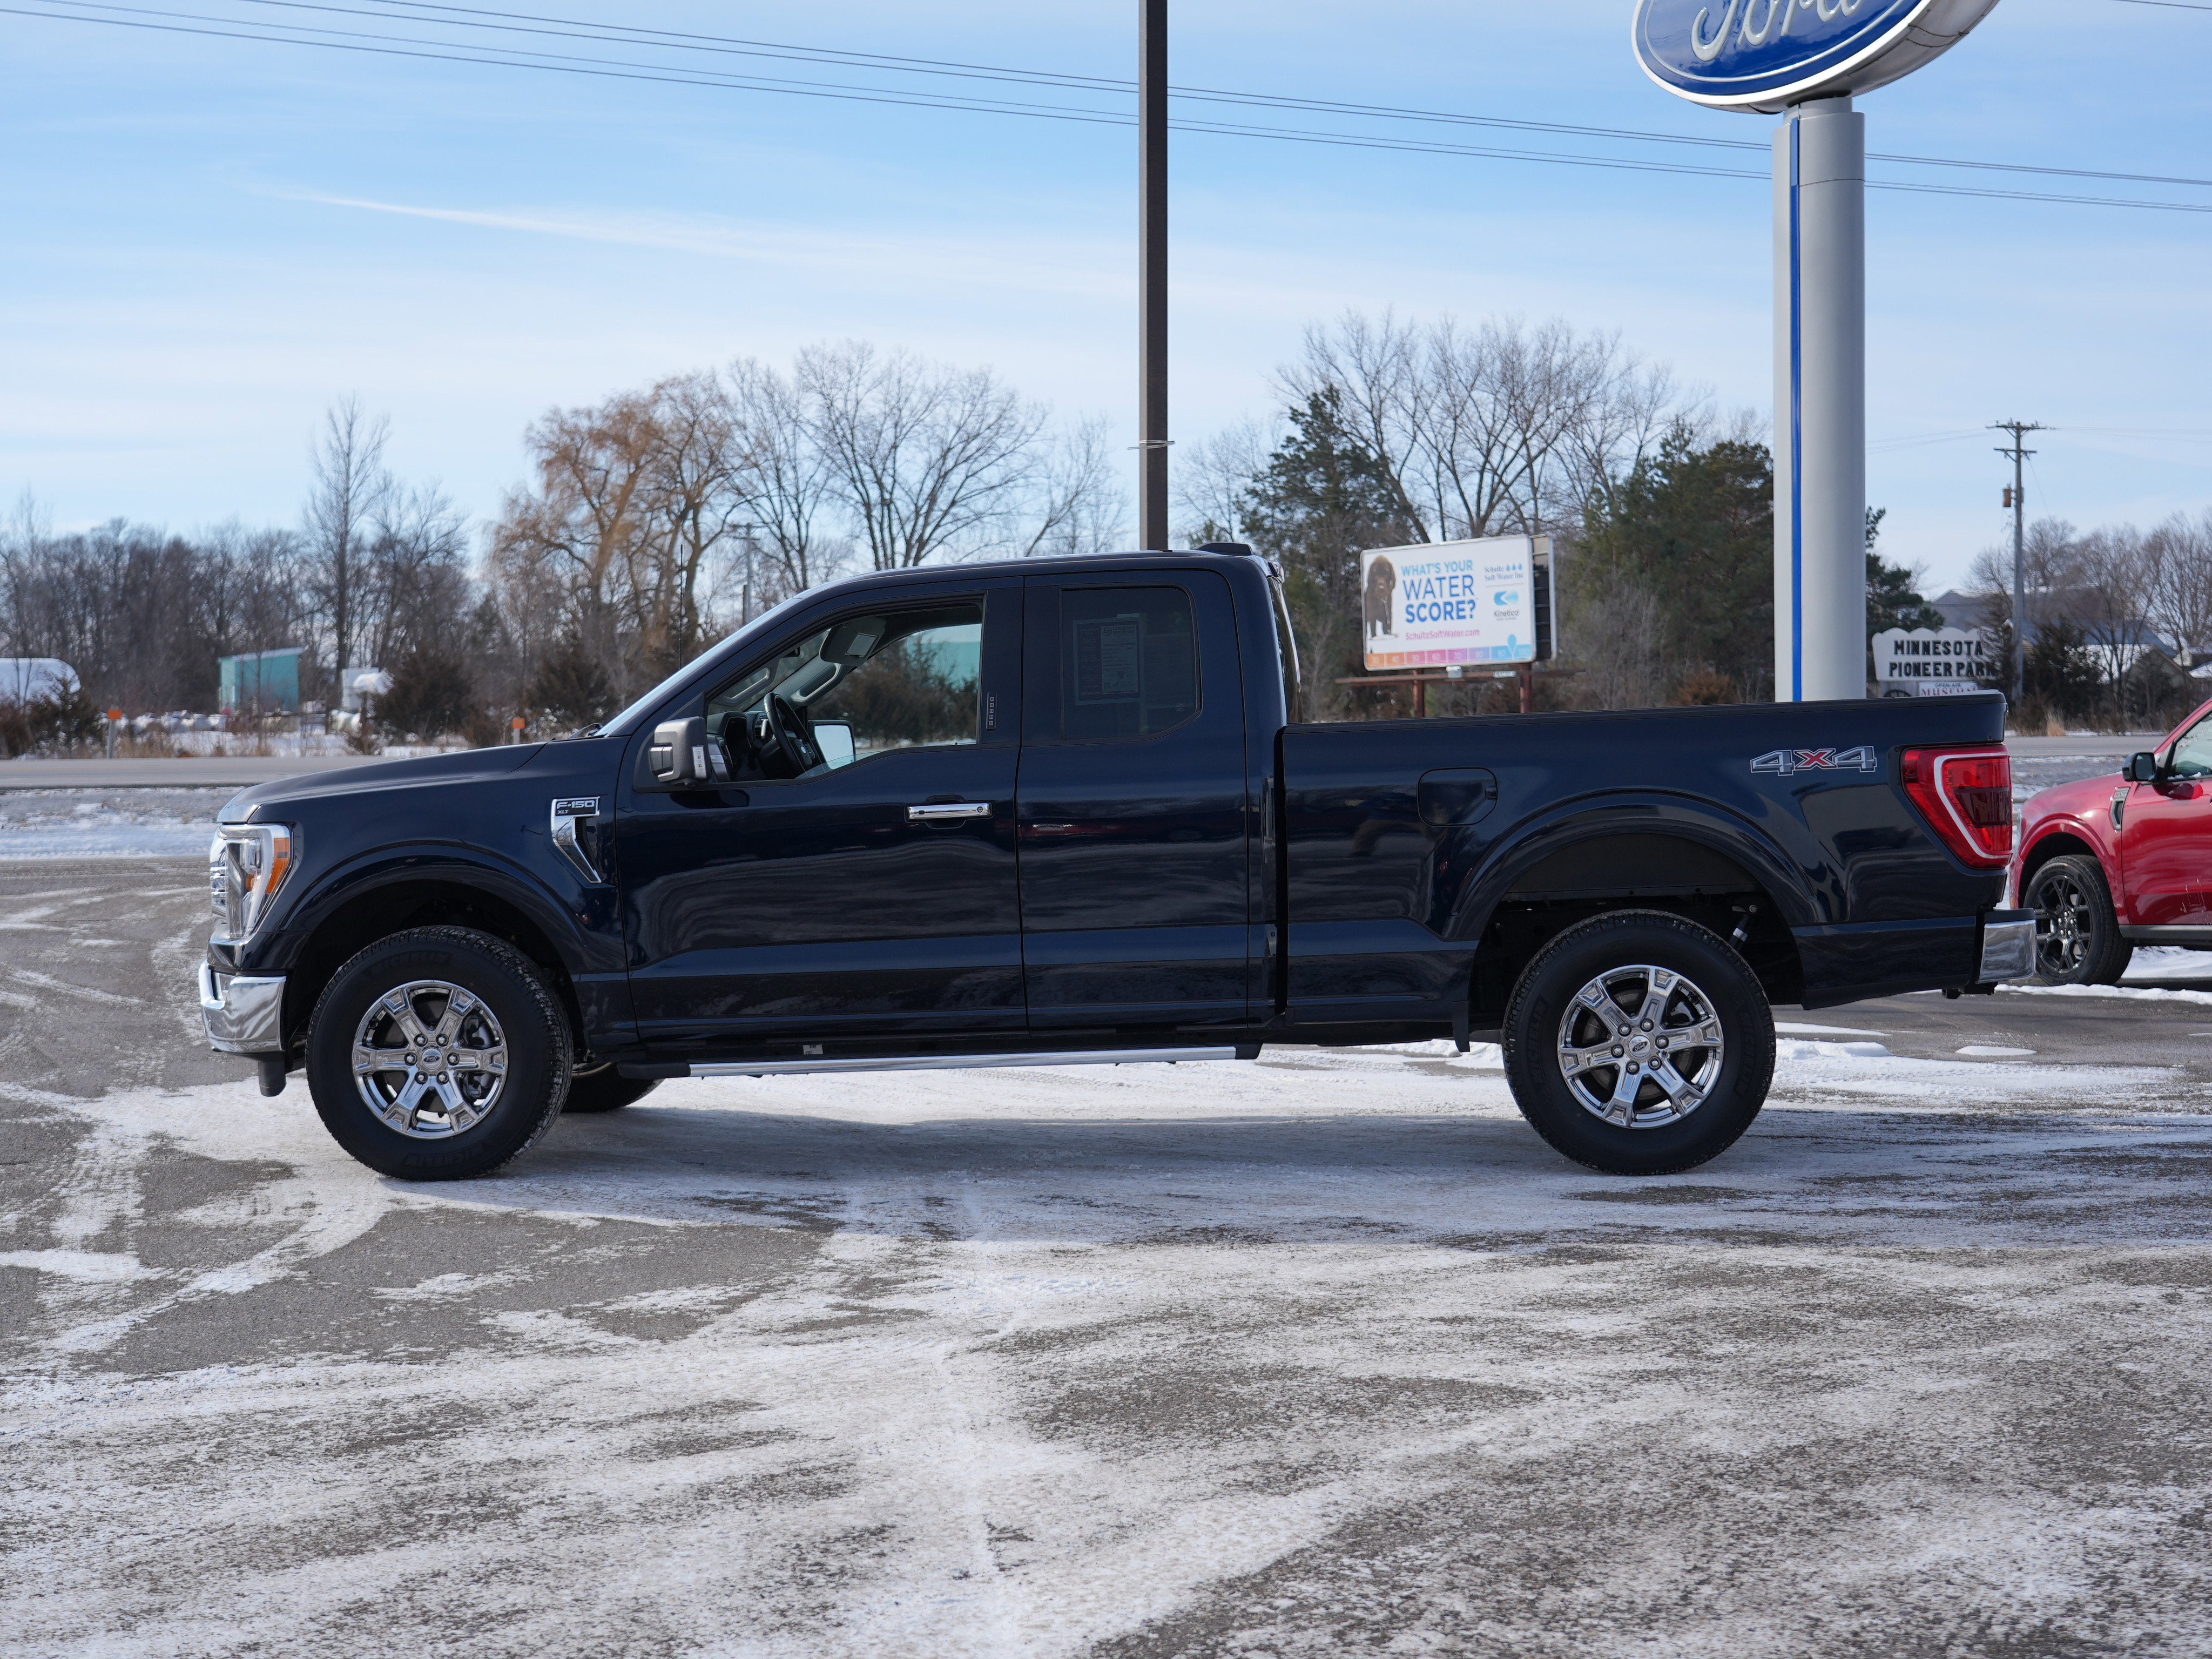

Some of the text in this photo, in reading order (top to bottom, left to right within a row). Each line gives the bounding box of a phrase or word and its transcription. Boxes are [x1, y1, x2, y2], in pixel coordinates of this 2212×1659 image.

[1401, 560, 1473, 576] WHAT'S YOUR
[1403, 575, 1474, 601] WATER
[1406, 599, 1476, 623] SCORE?
[1493, 609, 1519, 617] Kinetico
[1405, 629, 1480, 640] SchultzSoftWater.com
[1894, 640, 1982, 655] MINNESOTA
[1889, 662, 1952, 677] PIONEER
[556, 800, 595, 810] F-150
